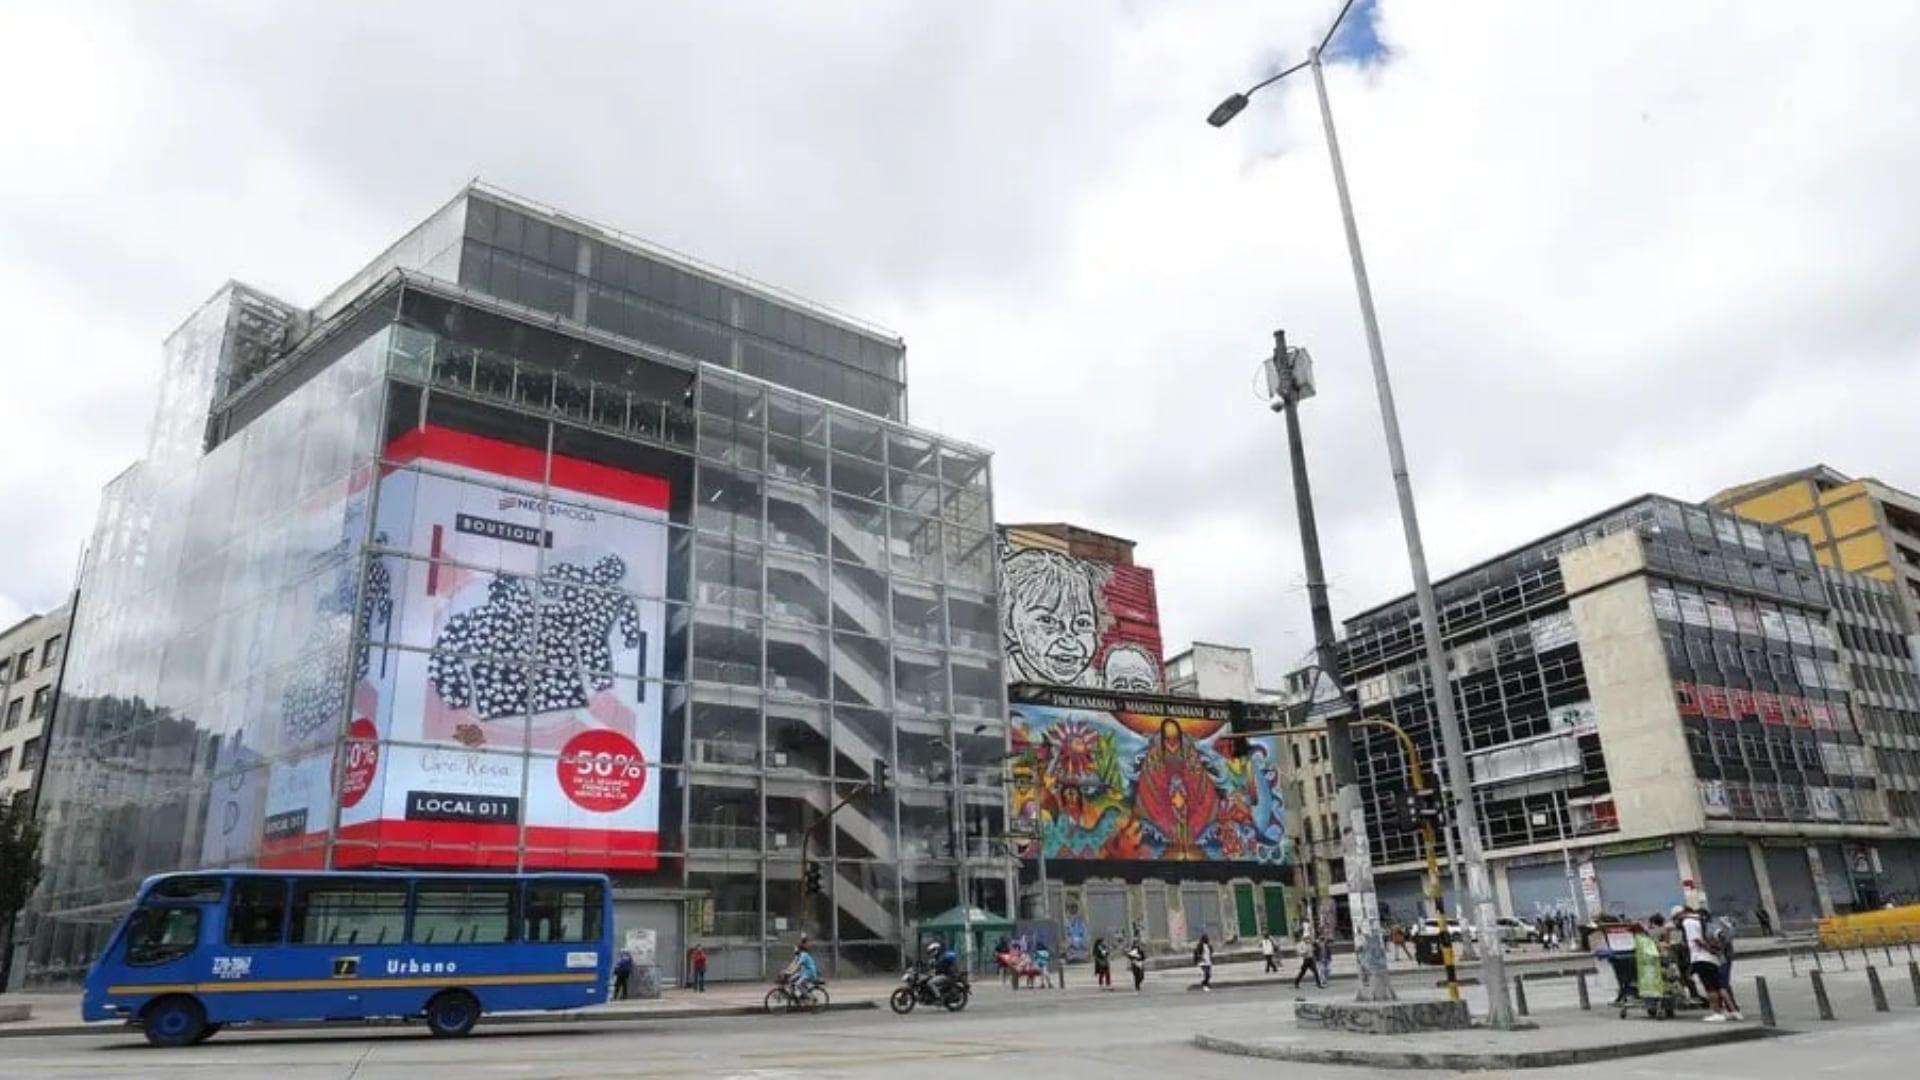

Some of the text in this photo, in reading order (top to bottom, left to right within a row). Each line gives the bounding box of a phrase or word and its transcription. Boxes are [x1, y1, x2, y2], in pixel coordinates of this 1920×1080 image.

[416, 799, 508, 816] LOCAL 011
[387, 957, 457, 974] Urbano
